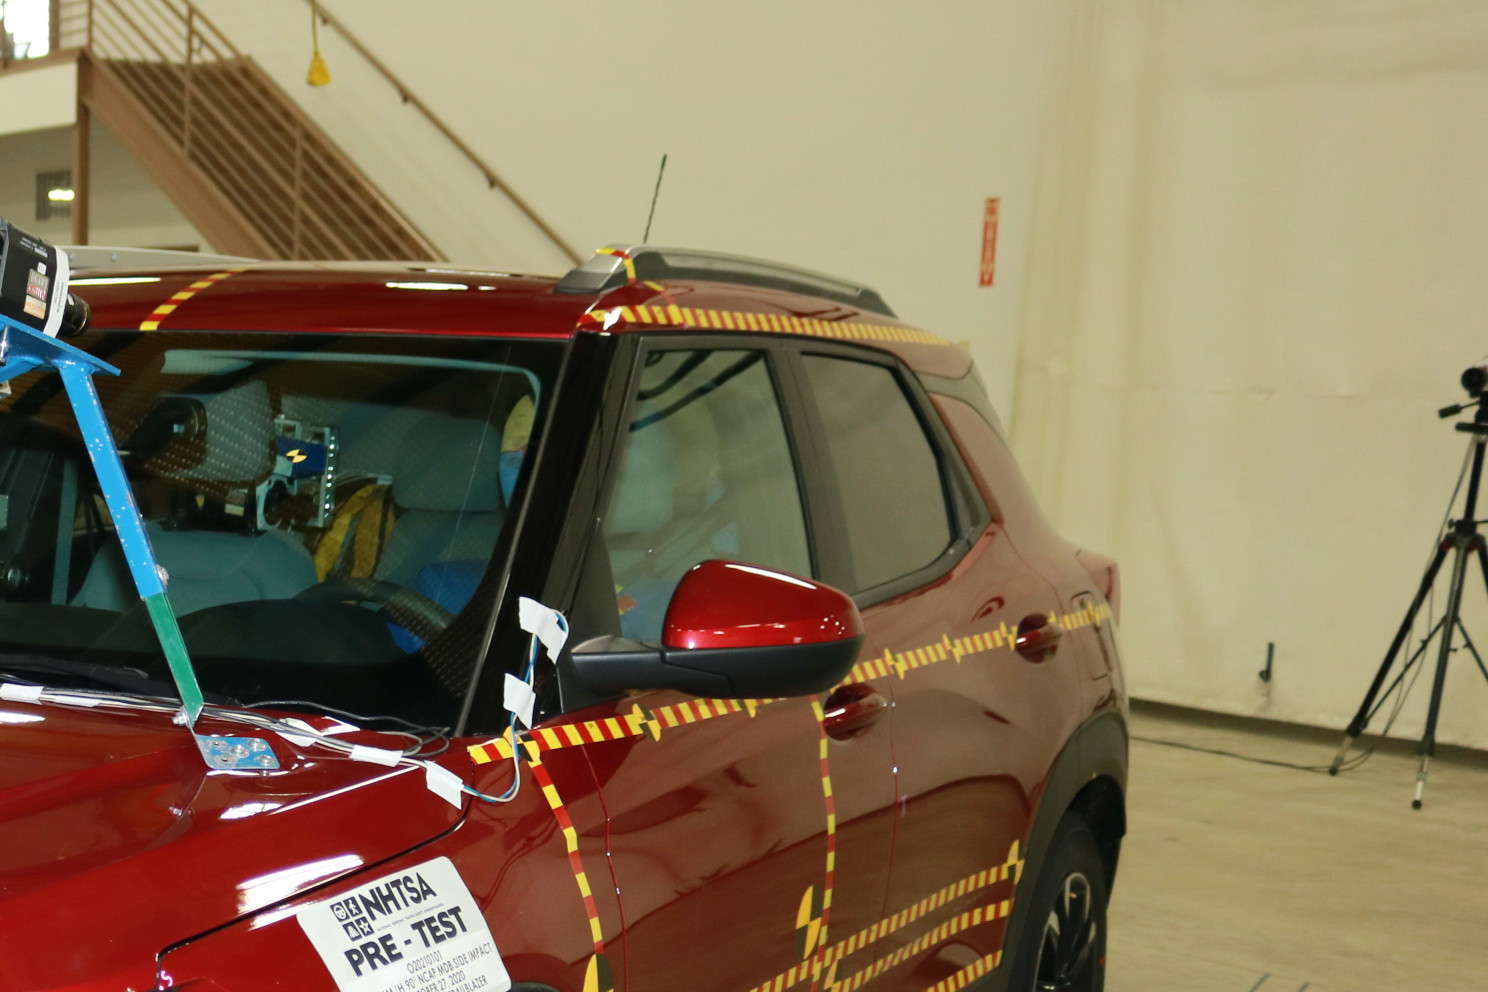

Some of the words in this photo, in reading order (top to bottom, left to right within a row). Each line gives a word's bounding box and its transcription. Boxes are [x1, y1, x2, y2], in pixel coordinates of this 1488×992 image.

[358, 872, 437, 921] NHTSA
[344, 933, 403, 977] PRE
[410, 905, 467, 948] TEST
[406, 950, 443, 974] O20210101
[418, 968, 436, 985] NCAP
[438, 961, 454, 976] MDB
[454, 954, 471, 968] SIDE
[468, 942, 493, 961] IMPACT
[448, 970, 466, 986] 2020
